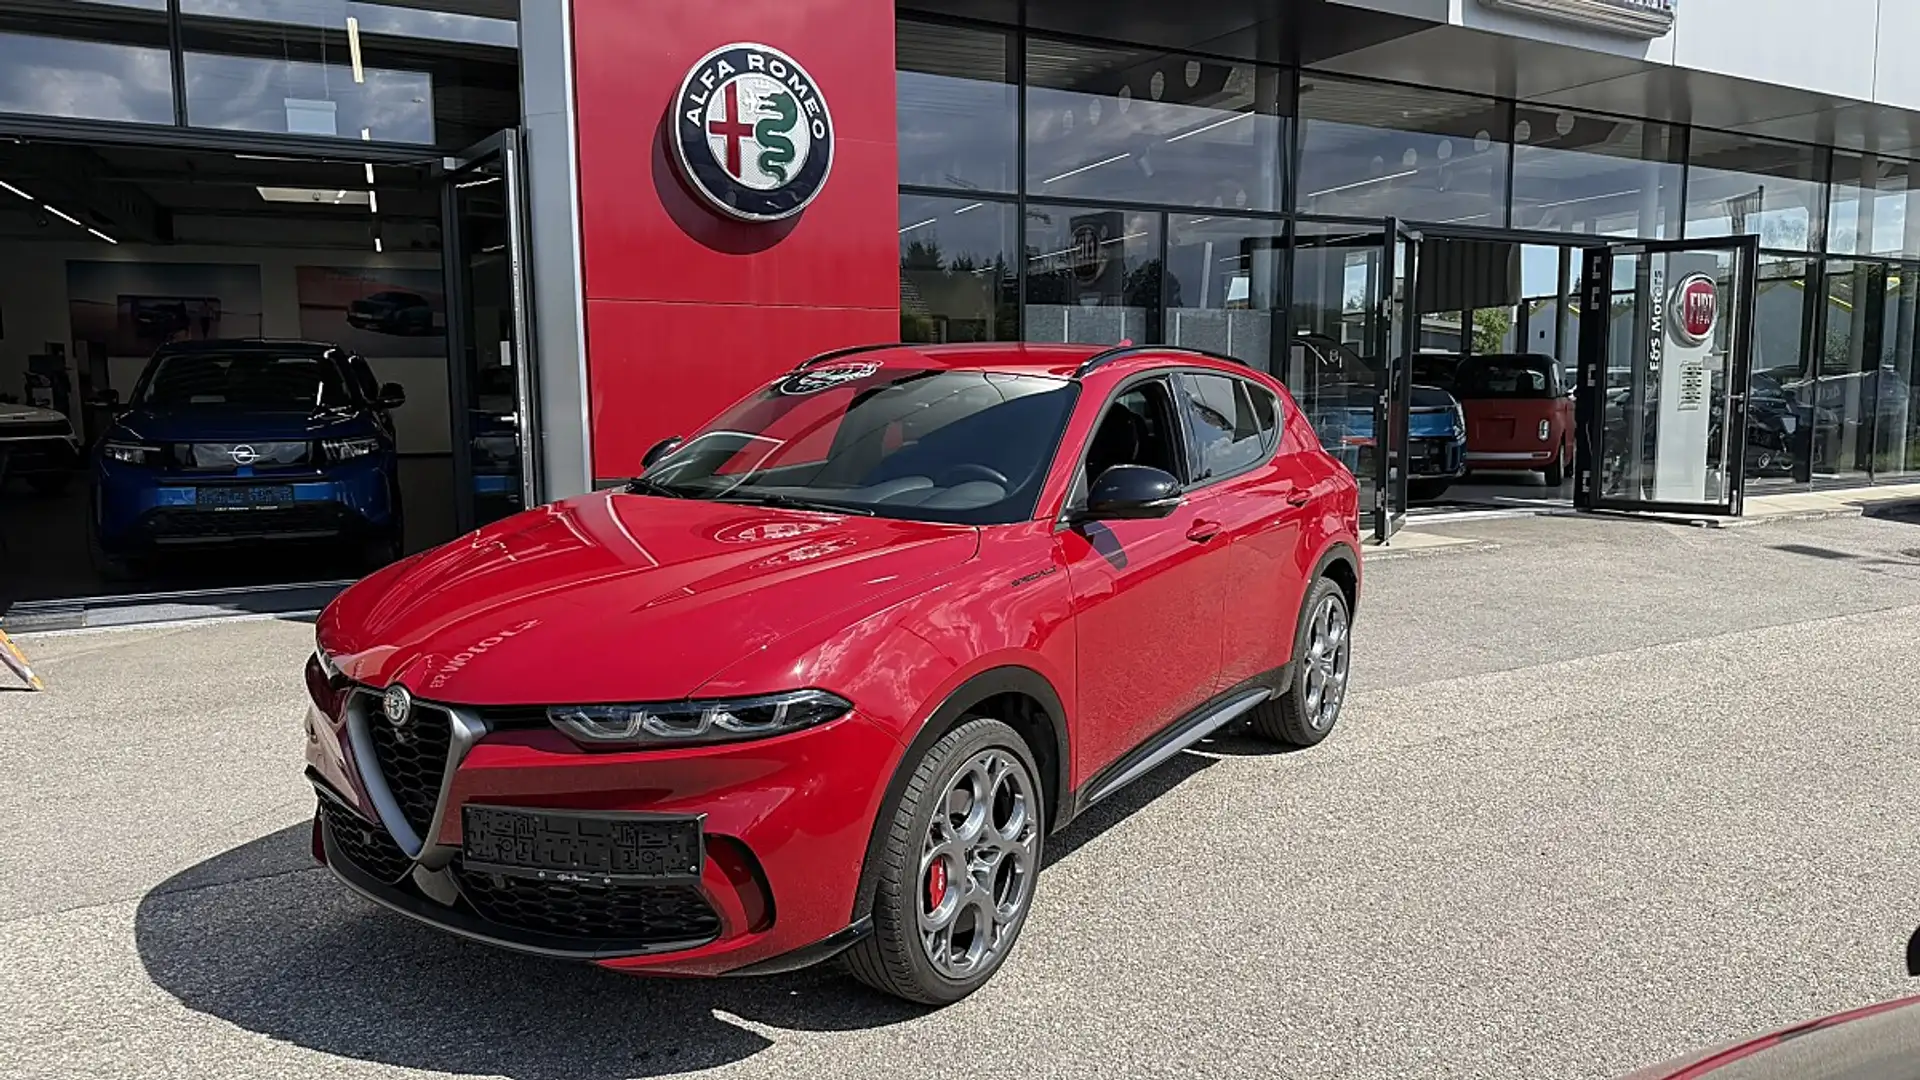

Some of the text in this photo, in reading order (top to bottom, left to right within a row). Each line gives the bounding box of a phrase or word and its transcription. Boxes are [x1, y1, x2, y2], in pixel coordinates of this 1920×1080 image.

[687, 53, 825, 139] ALFA ROMEO
[1649, 270, 1663, 370] E&S Motors
